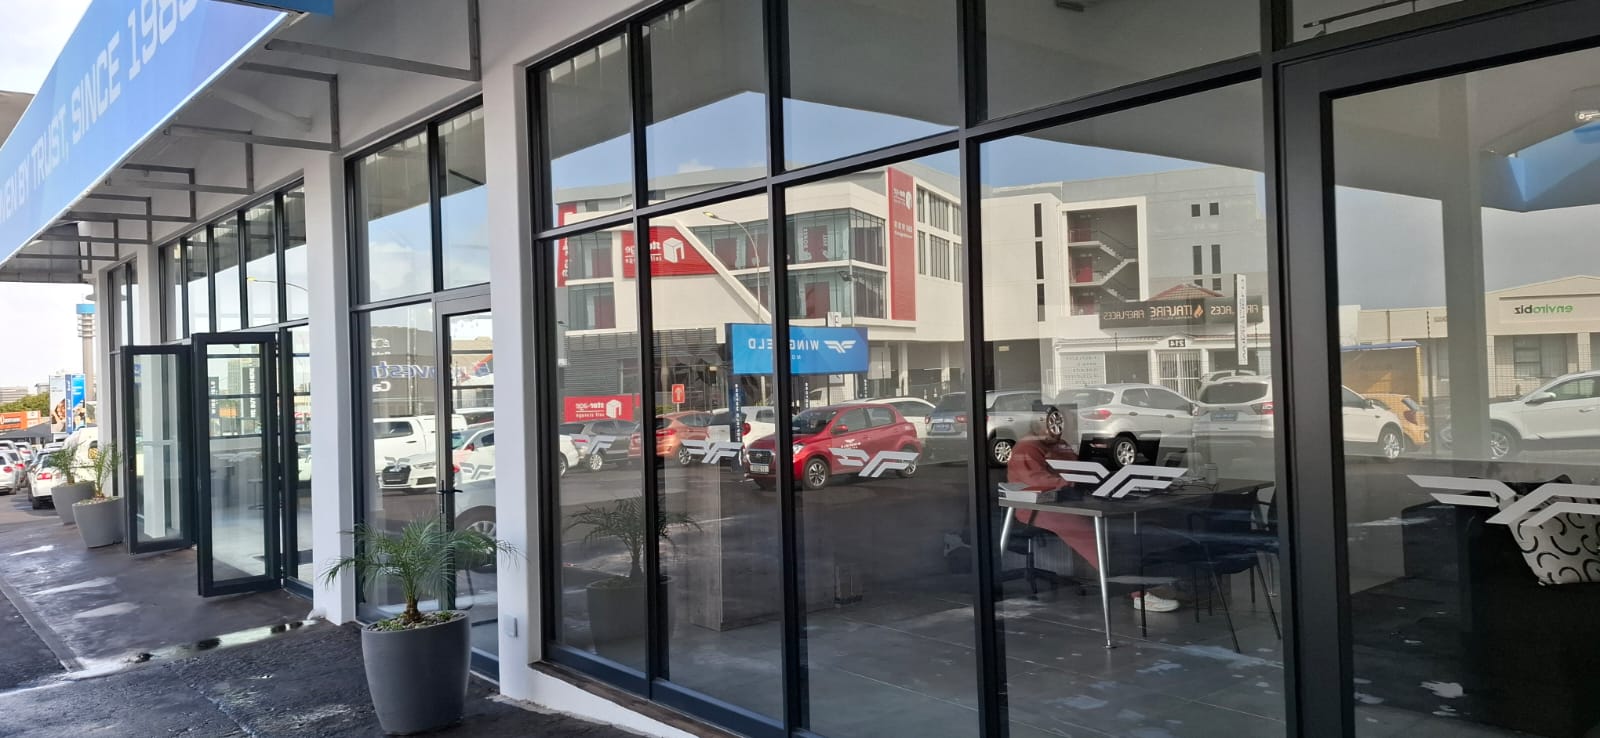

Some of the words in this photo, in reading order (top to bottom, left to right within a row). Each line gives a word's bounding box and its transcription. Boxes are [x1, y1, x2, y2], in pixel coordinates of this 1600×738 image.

[18, 153, 29, 206] BY
[31, 105, 69, 189] TRUST,
[71, 31, 121, 144] SINCE
